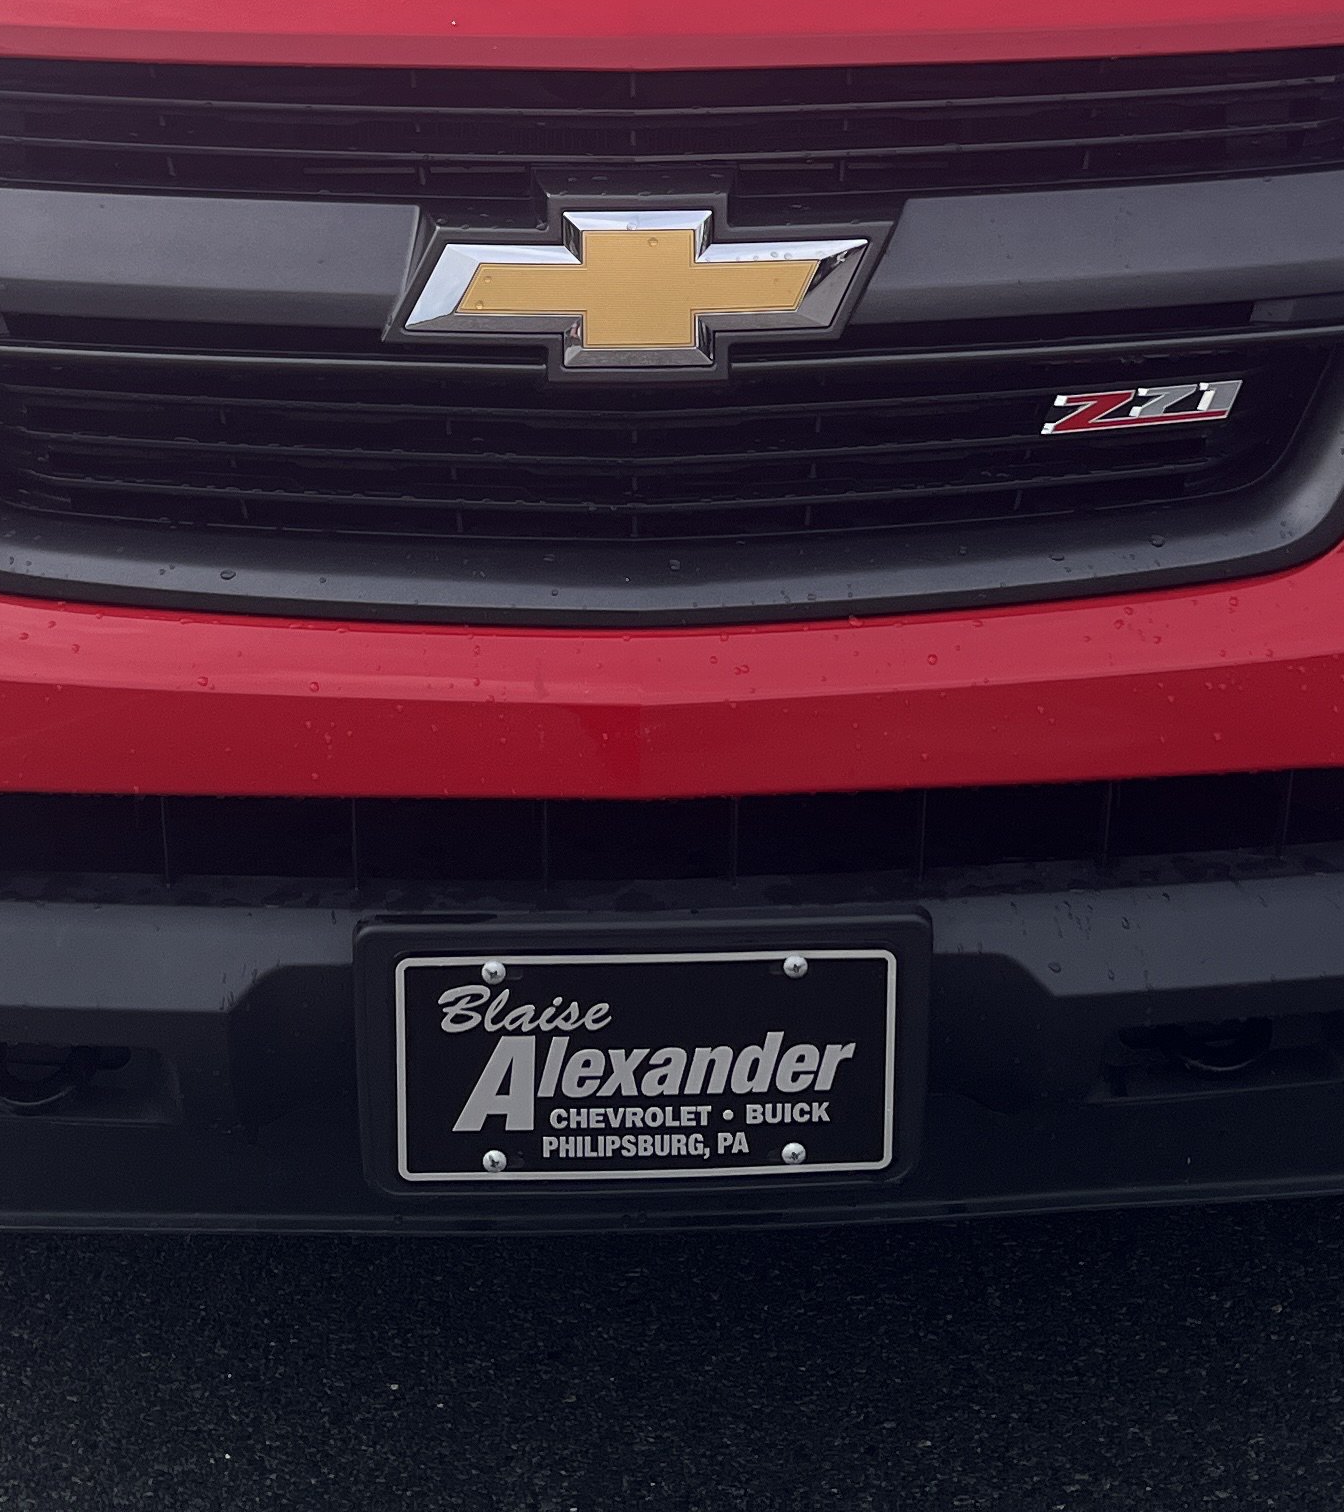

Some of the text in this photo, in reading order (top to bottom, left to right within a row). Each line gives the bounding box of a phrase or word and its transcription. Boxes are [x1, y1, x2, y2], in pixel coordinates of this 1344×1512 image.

[1041, 380, 1243, 435] Z71
[437, 984, 612, 1033] Blaise
[452, 1031, 855, 1132] Alexander
[549, 1102, 831, 1130] CHEVROLET BUICK
[542, 1132, 749, 1160] PHILIPSBURG, PA
